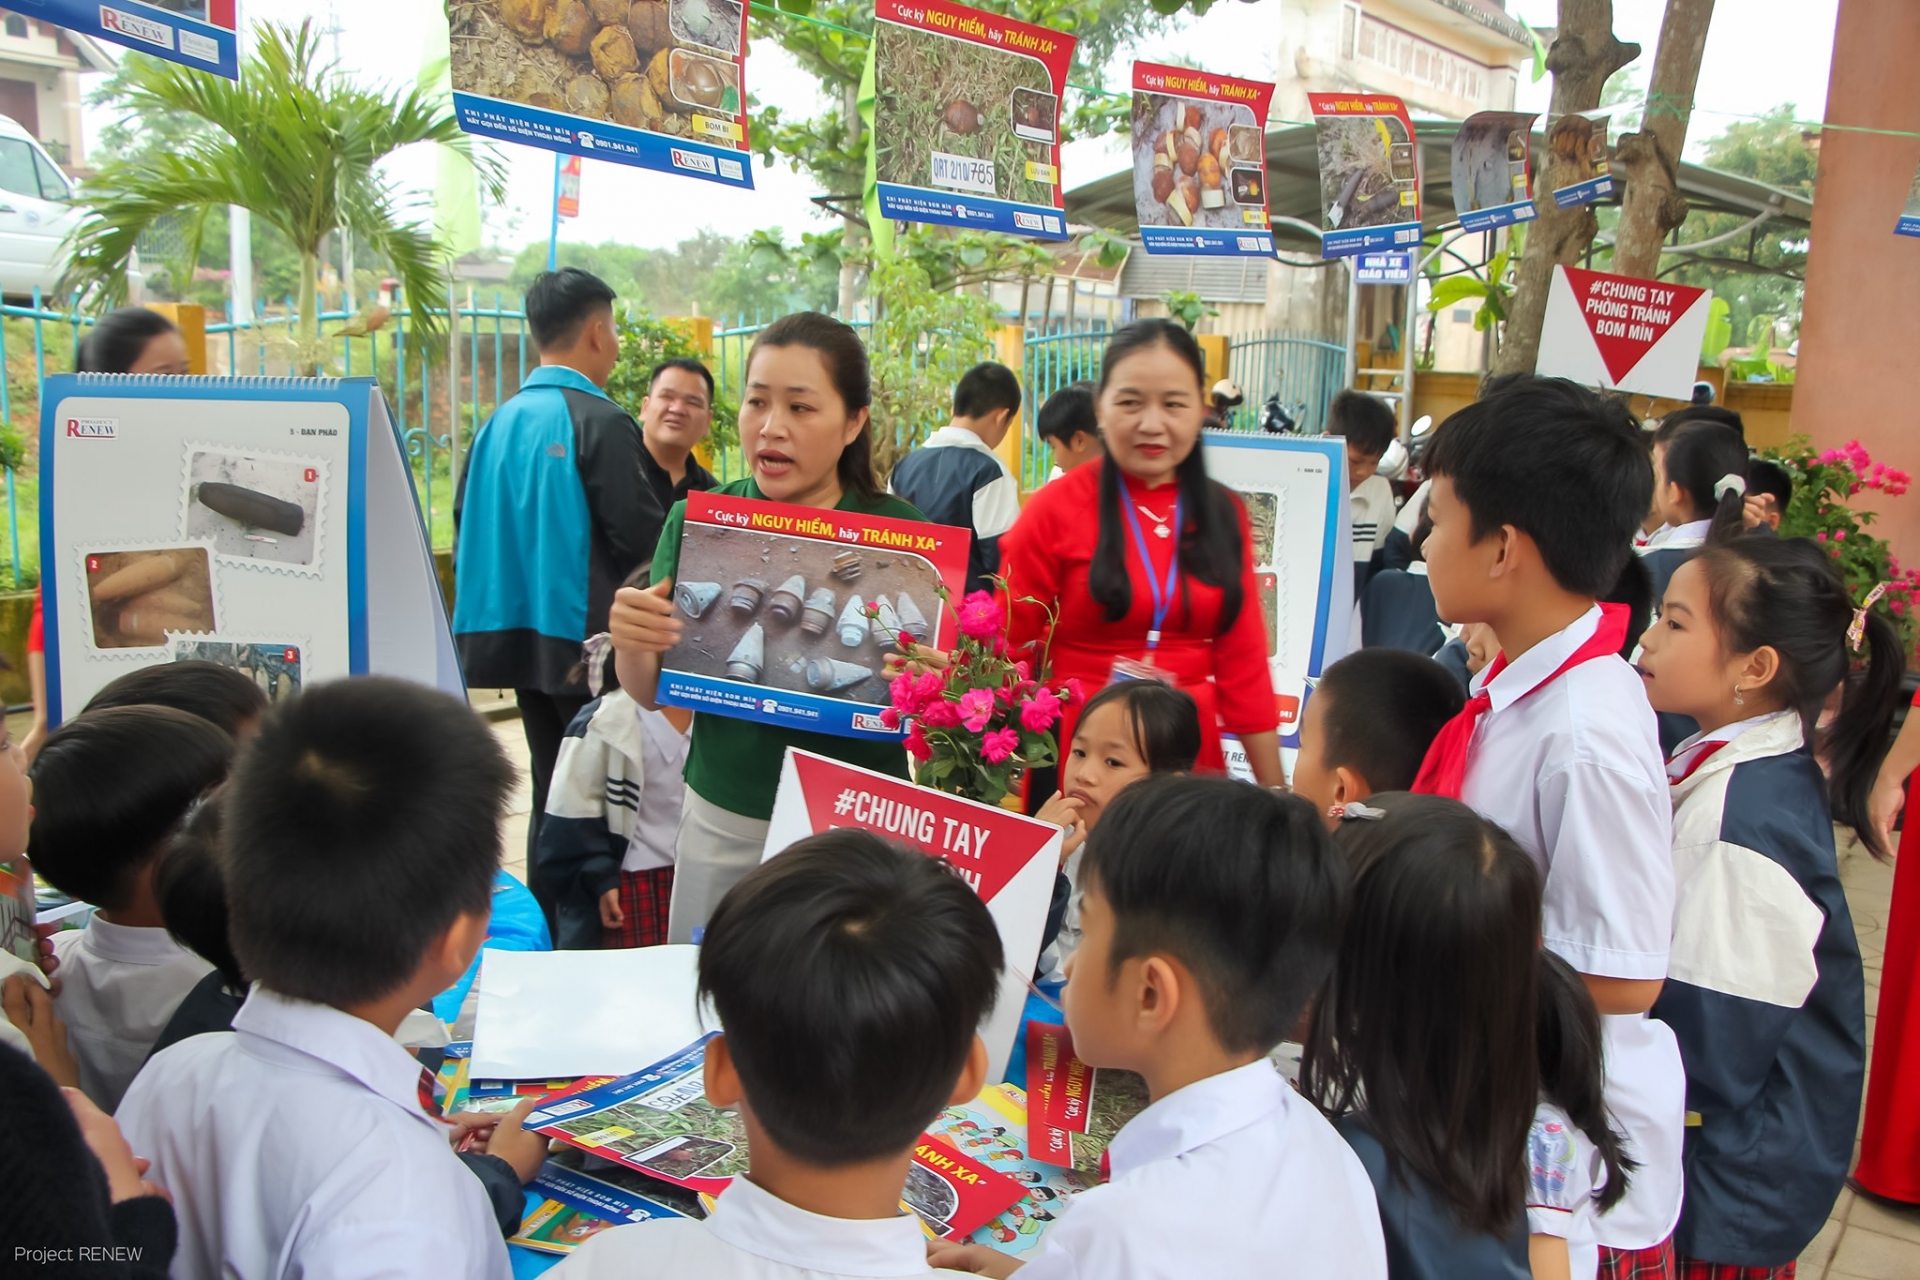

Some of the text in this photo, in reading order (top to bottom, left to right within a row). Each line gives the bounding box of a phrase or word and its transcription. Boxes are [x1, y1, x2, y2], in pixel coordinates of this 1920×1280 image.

[102, 8, 164, 41] RENEW
[914, 9, 925, 23] kỳ
[926, 9, 957, 29] NGUY
[958, 17, 986, 38] HIỂM,
[988, 28, 1003, 43] hãy
[1004, 26, 1041, 50] TRÁNH
[1165, 76, 1187, 89] NGUY
[1220, 84, 1247, 98] TRÁNH
[464, 109, 571, 136] KHI PHÁT HIỆN BOM MÌN
[704, 121, 721, 131] BOM
[673, 151, 710, 169] RENEW
[1365, 255, 1402, 268] NHÀ XE
[1358, 268, 1408, 279] GIÁO VIÊN
[1590, 280, 1675, 306] #CHUNG TAY
[1585, 298, 1671, 325] PHÒNG TRÁNH
[1596, 319, 1654, 342] BOM MÌN
[67, 419, 114, 437] RENEW
[736, 513, 749, 527] kỳ
[751, 512, 794, 530] NGUY
[795, 517, 837, 538] HIỂM,
[839, 527, 860, 542] hãy
[862, 527, 913, 548] TRÁNH
[91, 560, 98, 569] 2
[1265, 577, 1271, 586] 2
[287, 651, 293, 659] 3
[685, 685, 703, 693] PHÁT
[705, 689, 723, 697] HIỆN
[725, 692, 740, 700] BOM
[742, 695, 757, 703] MÌN
[834, 788, 991, 860] #CHUNG TAY
[1065, 1080, 1082, 1098] NGUY
[914, 1144, 956, 1170] ÁNH
